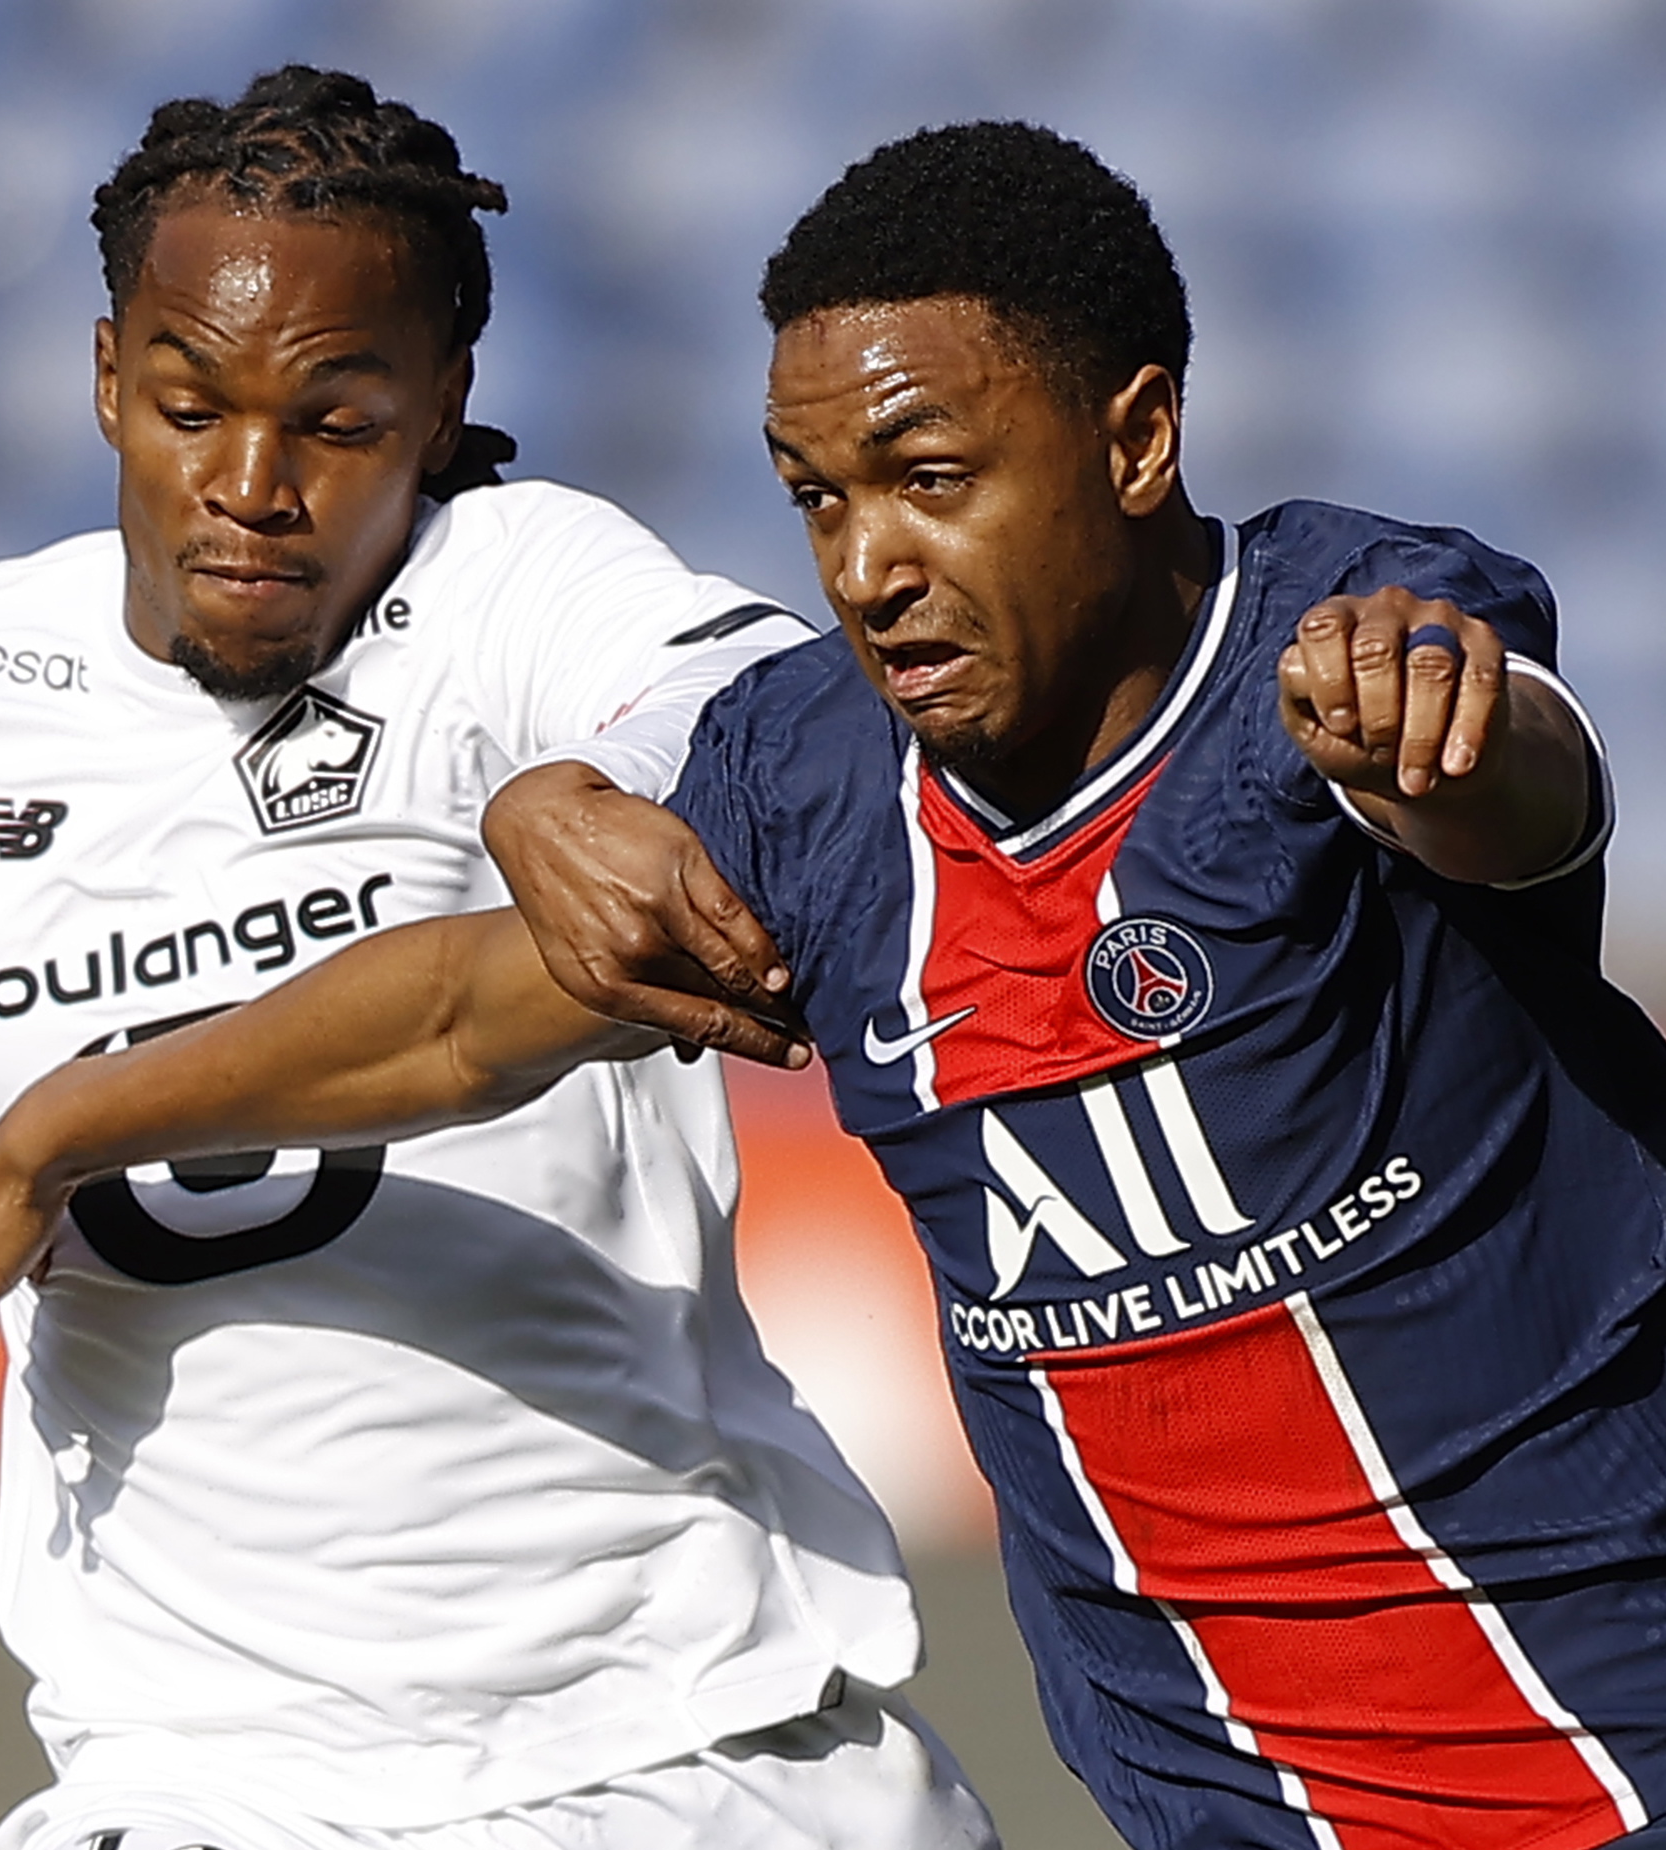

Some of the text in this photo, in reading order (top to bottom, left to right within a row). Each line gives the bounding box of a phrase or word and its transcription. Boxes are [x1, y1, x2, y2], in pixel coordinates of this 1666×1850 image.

[275, 782, 349, 820] LOSC
[1095, 925, 1167, 970] PARIS
[951, 1155, 1423, 1352] CCOR LIVE LIMITLESS
